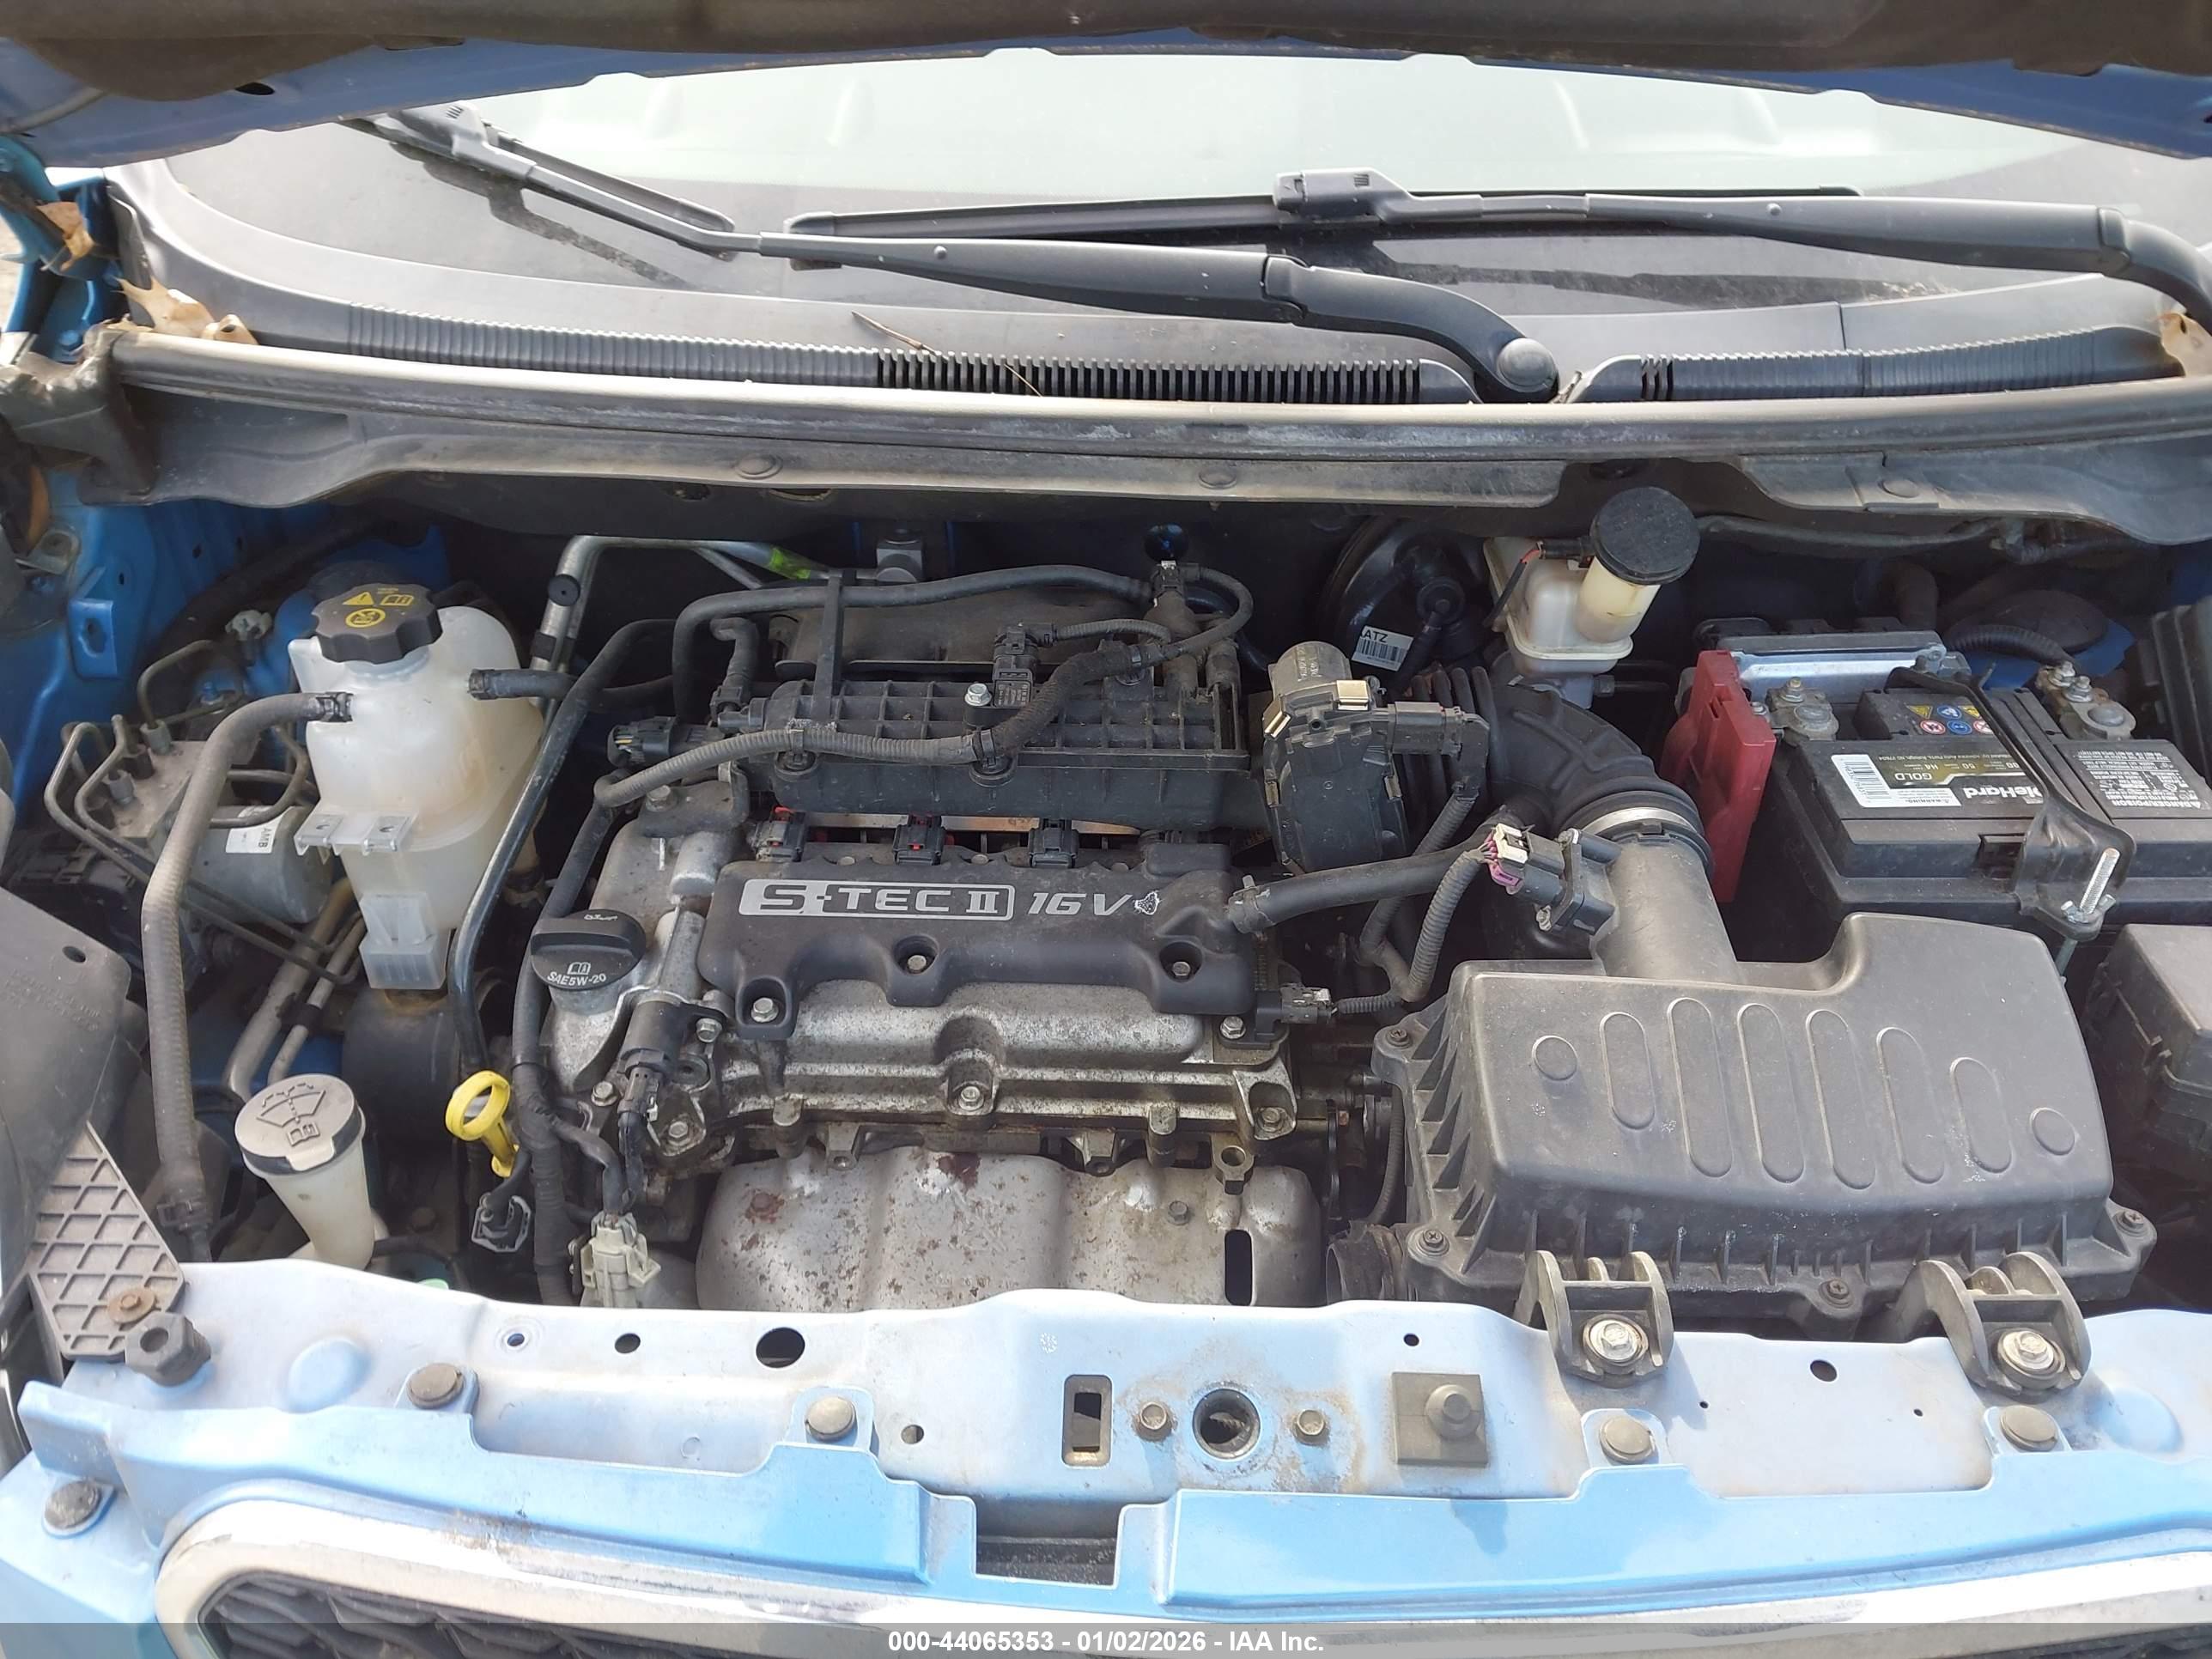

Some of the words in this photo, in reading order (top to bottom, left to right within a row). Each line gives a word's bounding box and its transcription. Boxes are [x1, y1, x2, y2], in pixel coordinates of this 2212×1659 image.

[1362, 629, 1389, 643] ATZ
[760, 884, 951, 913] S-TEC
[965, 890, 1000, 915] II
